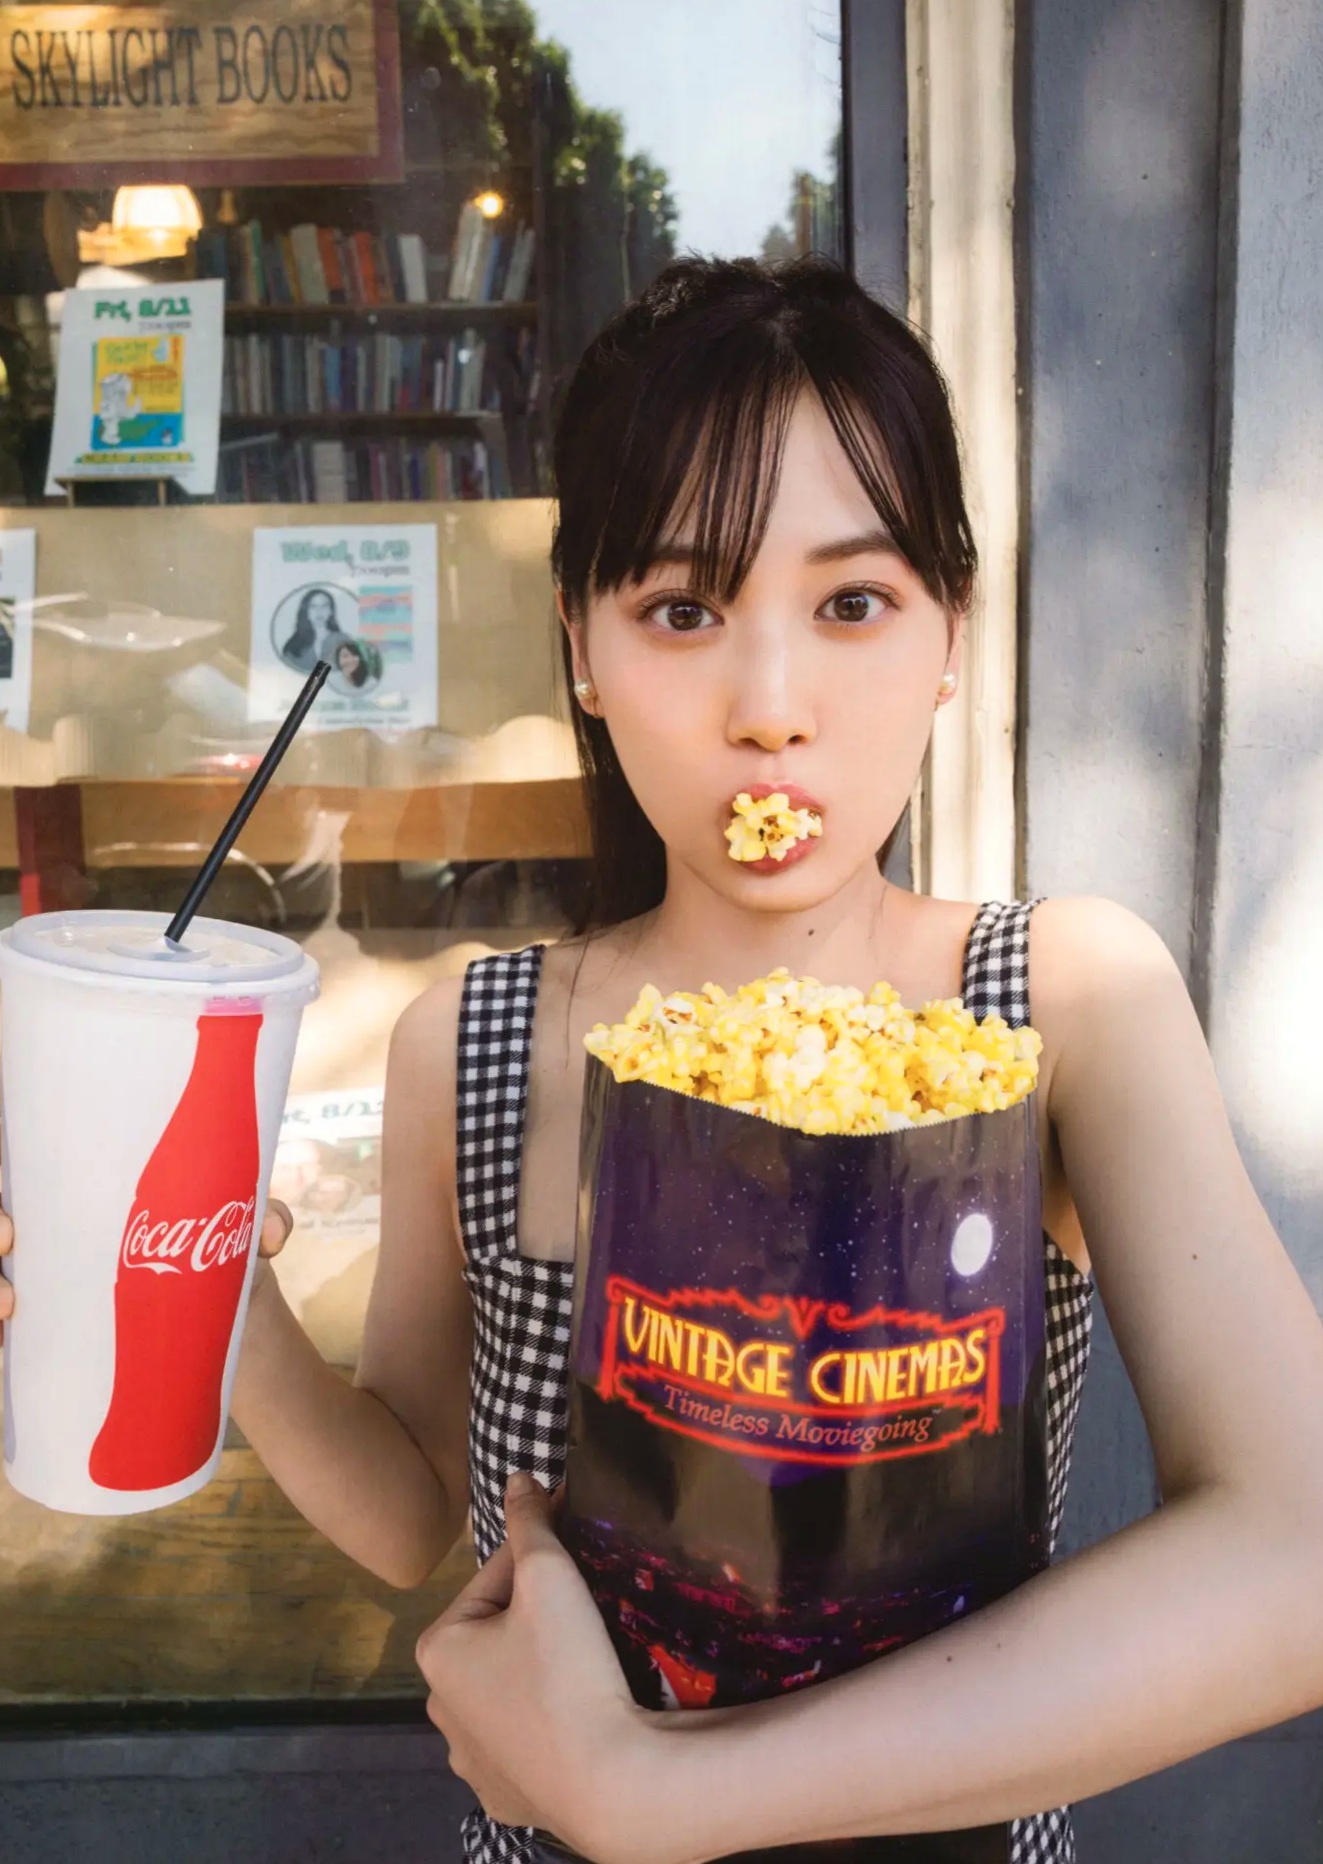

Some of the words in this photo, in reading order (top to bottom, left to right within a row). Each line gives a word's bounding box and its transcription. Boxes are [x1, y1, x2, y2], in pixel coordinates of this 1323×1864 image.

[11, 28, 202, 109] SKYLIGHT
[213, 24, 352, 105] BOOKS
[122, 1195, 254, 1275] Coca-Cola
[622, 1296, 796, 1398] VINTAGE
[810, 1328, 987, 1405] CINEMAS
[664, 1384, 769, 1436] Timeless
[776, 1413, 933, 1453] Moviegoing
